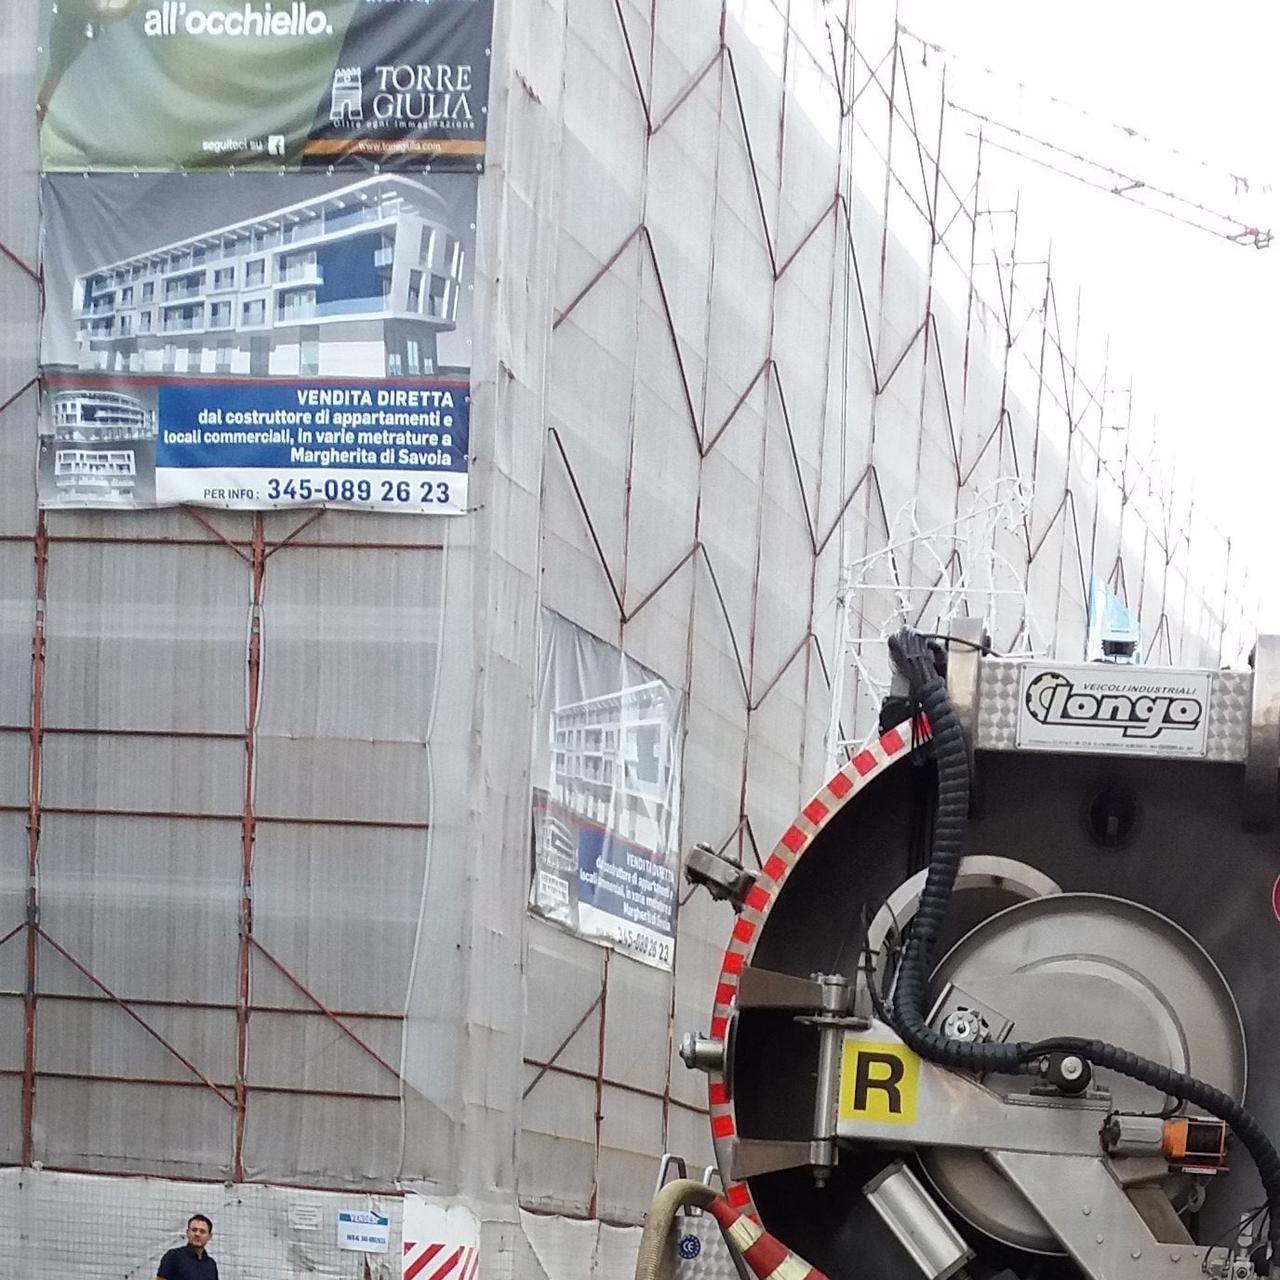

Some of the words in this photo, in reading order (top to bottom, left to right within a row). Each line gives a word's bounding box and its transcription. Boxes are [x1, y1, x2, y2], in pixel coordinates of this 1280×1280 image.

[144, 1, 333, 38] all'occhiello.
[375, 64, 472, 92] TORRE
[372, 92, 473, 119] GIULIA
[297, 389, 372, 407] VENDITA
[377, 390, 454, 408] DIRETTA
[198, 409, 222, 425] dal
[225, 410, 312, 425] costruttore
[315, 409, 330, 425] di
[332, 410, 441, 428] appartamenti
[443, 415, 453, 427] e
[163, 428, 201, 444] locali
[203, 428, 294, 446] commerciali,
[297, 428, 313, 444] in
[315, 429, 355, 445] varie
[357, 431, 439, 446] metrature
[441, 434, 452, 446] a
[290, 446, 377, 466] Margherita
[380, 448, 395, 465] di
[398, 448, 452, 466] Savoia
[203, 488, 226, 500] PER
[267, 478, 371, 501] 345-089
[380, 480, 411, 503] 26
[420, 481, 450, 503] 23
[1083, 682, 1126, 692] VEICOLI
[1126, 683, 1197, 695] INDUSTRIALI
[853, 1051, 905, 1114] R
